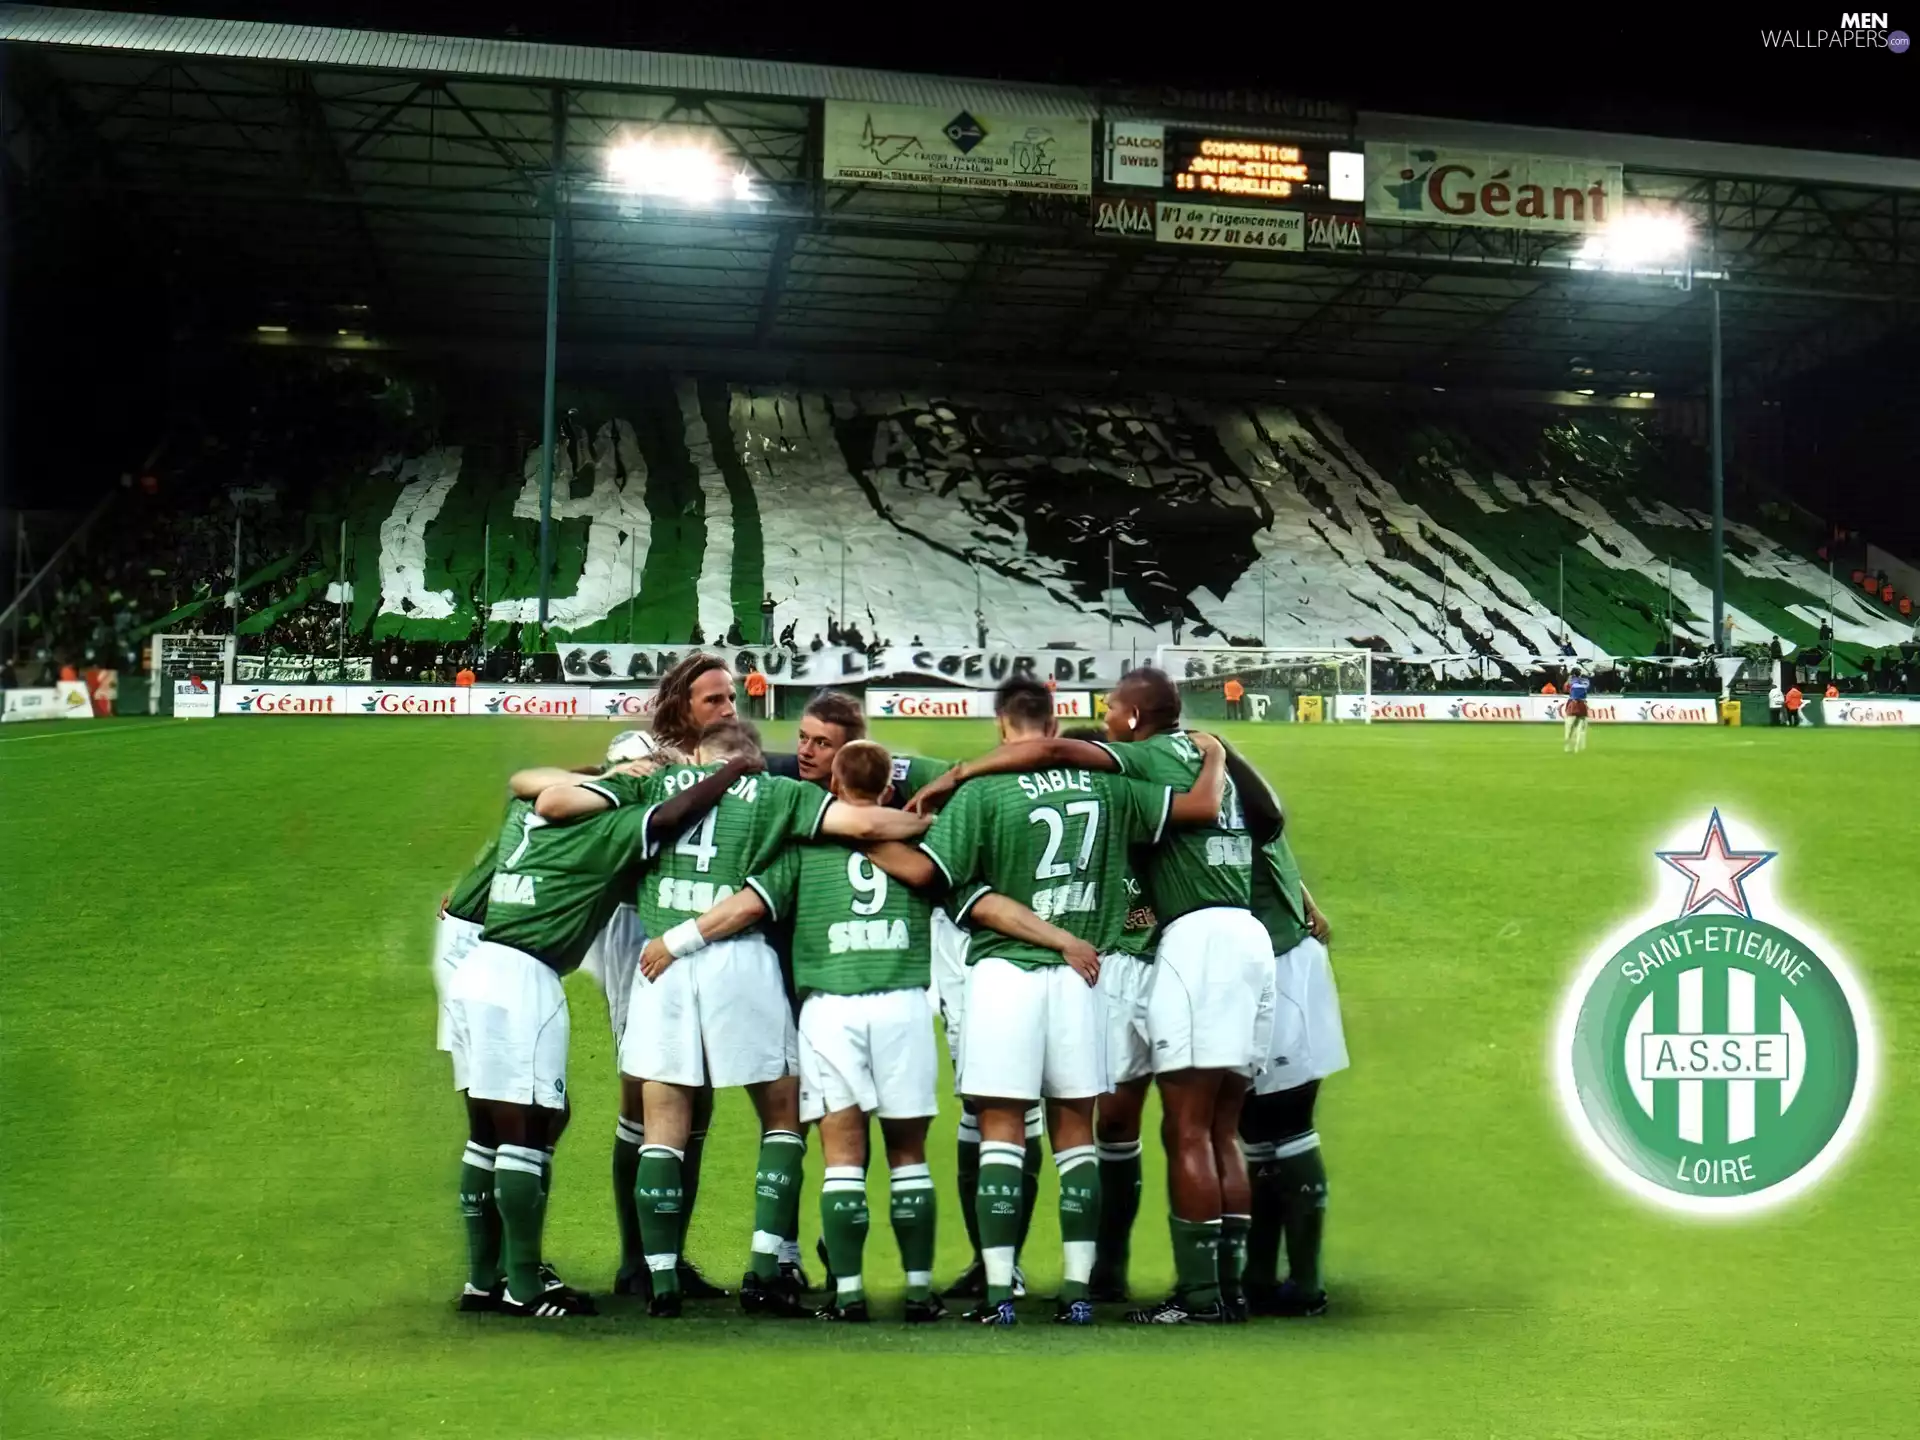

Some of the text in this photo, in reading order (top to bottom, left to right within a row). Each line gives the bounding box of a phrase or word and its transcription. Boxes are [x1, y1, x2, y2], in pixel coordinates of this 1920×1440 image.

[1428, 164, 1608, 222] Géant
[1187, 210, 1203, 222] de
[1200, 228, 1220, 242] 77
[842, 649, 886, 675] LE
[1055, 656, 1098, 681] DE
[256, 693, 335, 712] Géant
[381, 694, 456, 713] Géant
[503, 695, 577, 714] Géant
[898, 697, 969, 716] Géant
[1462, 702, 1521, 719] Géant
[1017, 768, 1092, 799] SABLE
[675, 805, 718, 872] 4
[1028, 800, 1100, 880] 27
[847, 851, 888, 915] 9
